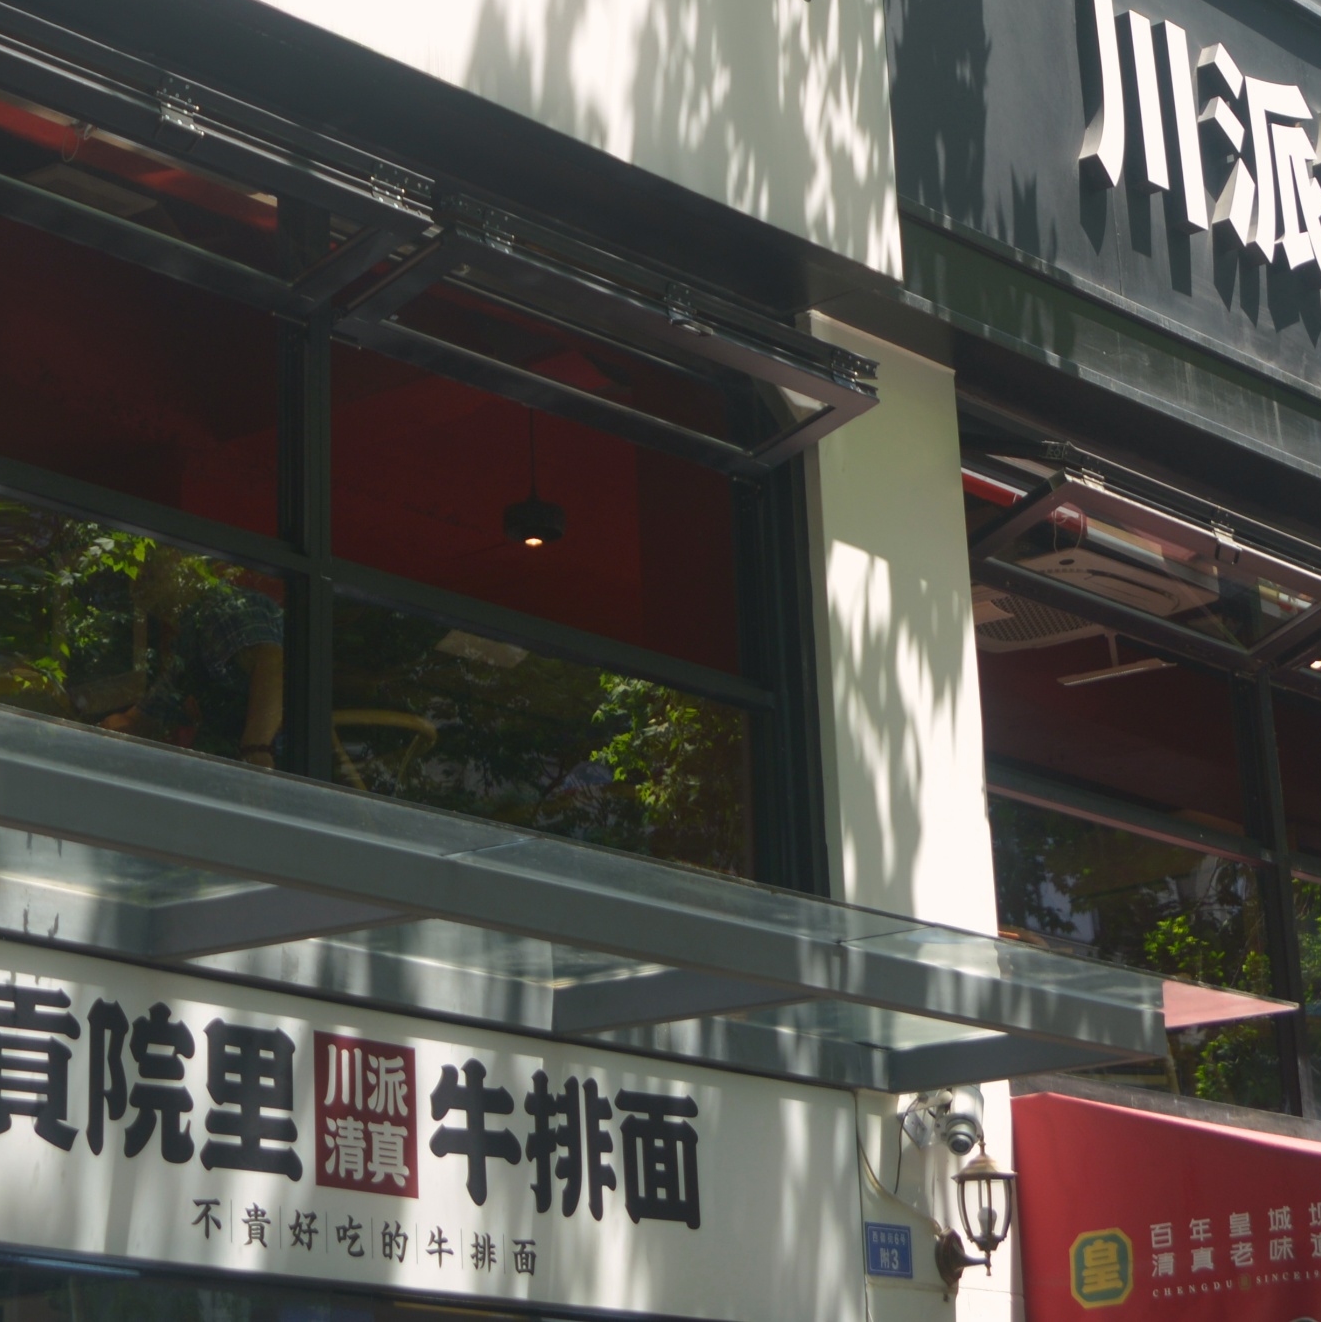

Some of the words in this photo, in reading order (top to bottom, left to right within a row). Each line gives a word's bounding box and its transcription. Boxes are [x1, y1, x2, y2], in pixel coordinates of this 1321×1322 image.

[325, 1043, 409, 1117] 川派
[324, 1116, 411, 1187] 清真
[429, 1058, 701, 1230] 牛排面
[191, 1197, 537, 1276] 不貴好吃的牛排面
[1081, 1238, 1124, 1295] 皇
[1152, 1278, 1234, 1298] CHENGDU
